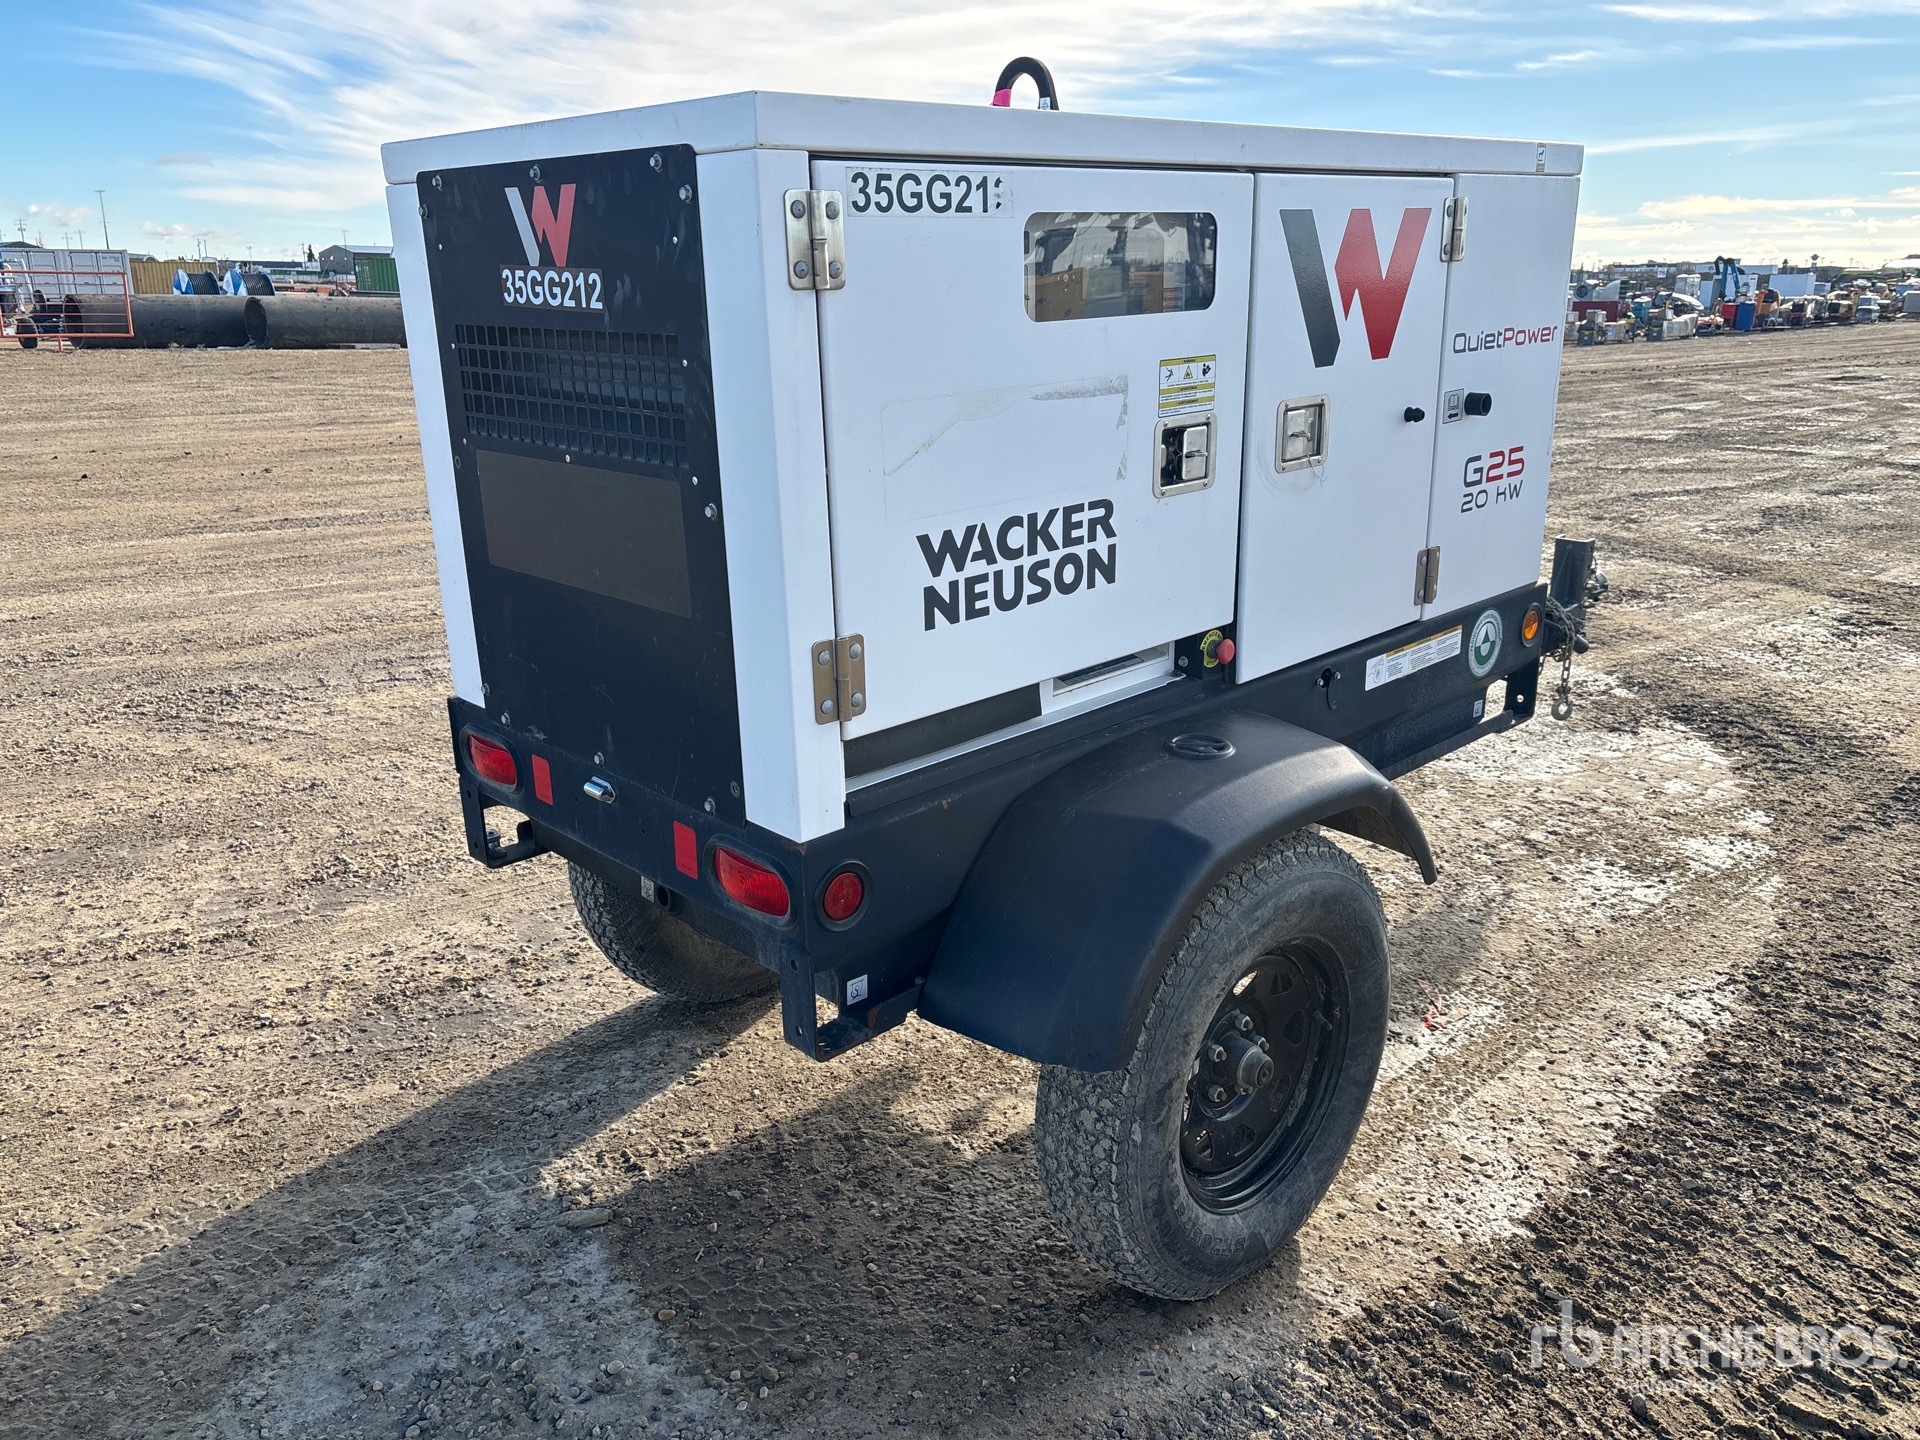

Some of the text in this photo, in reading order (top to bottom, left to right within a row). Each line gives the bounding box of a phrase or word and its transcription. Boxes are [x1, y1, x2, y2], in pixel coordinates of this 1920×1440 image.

[502, 268, 603, 309] 35GG212
[1453, 325, 1558, 354] QuietPower
[1463, 446, 1525, 488] G25
[1461, 489, 1489, 513] 20
[916, 498, 1117, 578] WACKER
[923, 543, 1117, 632] NEUSON
[1201, 631, 1222, 650] EMERGEN
